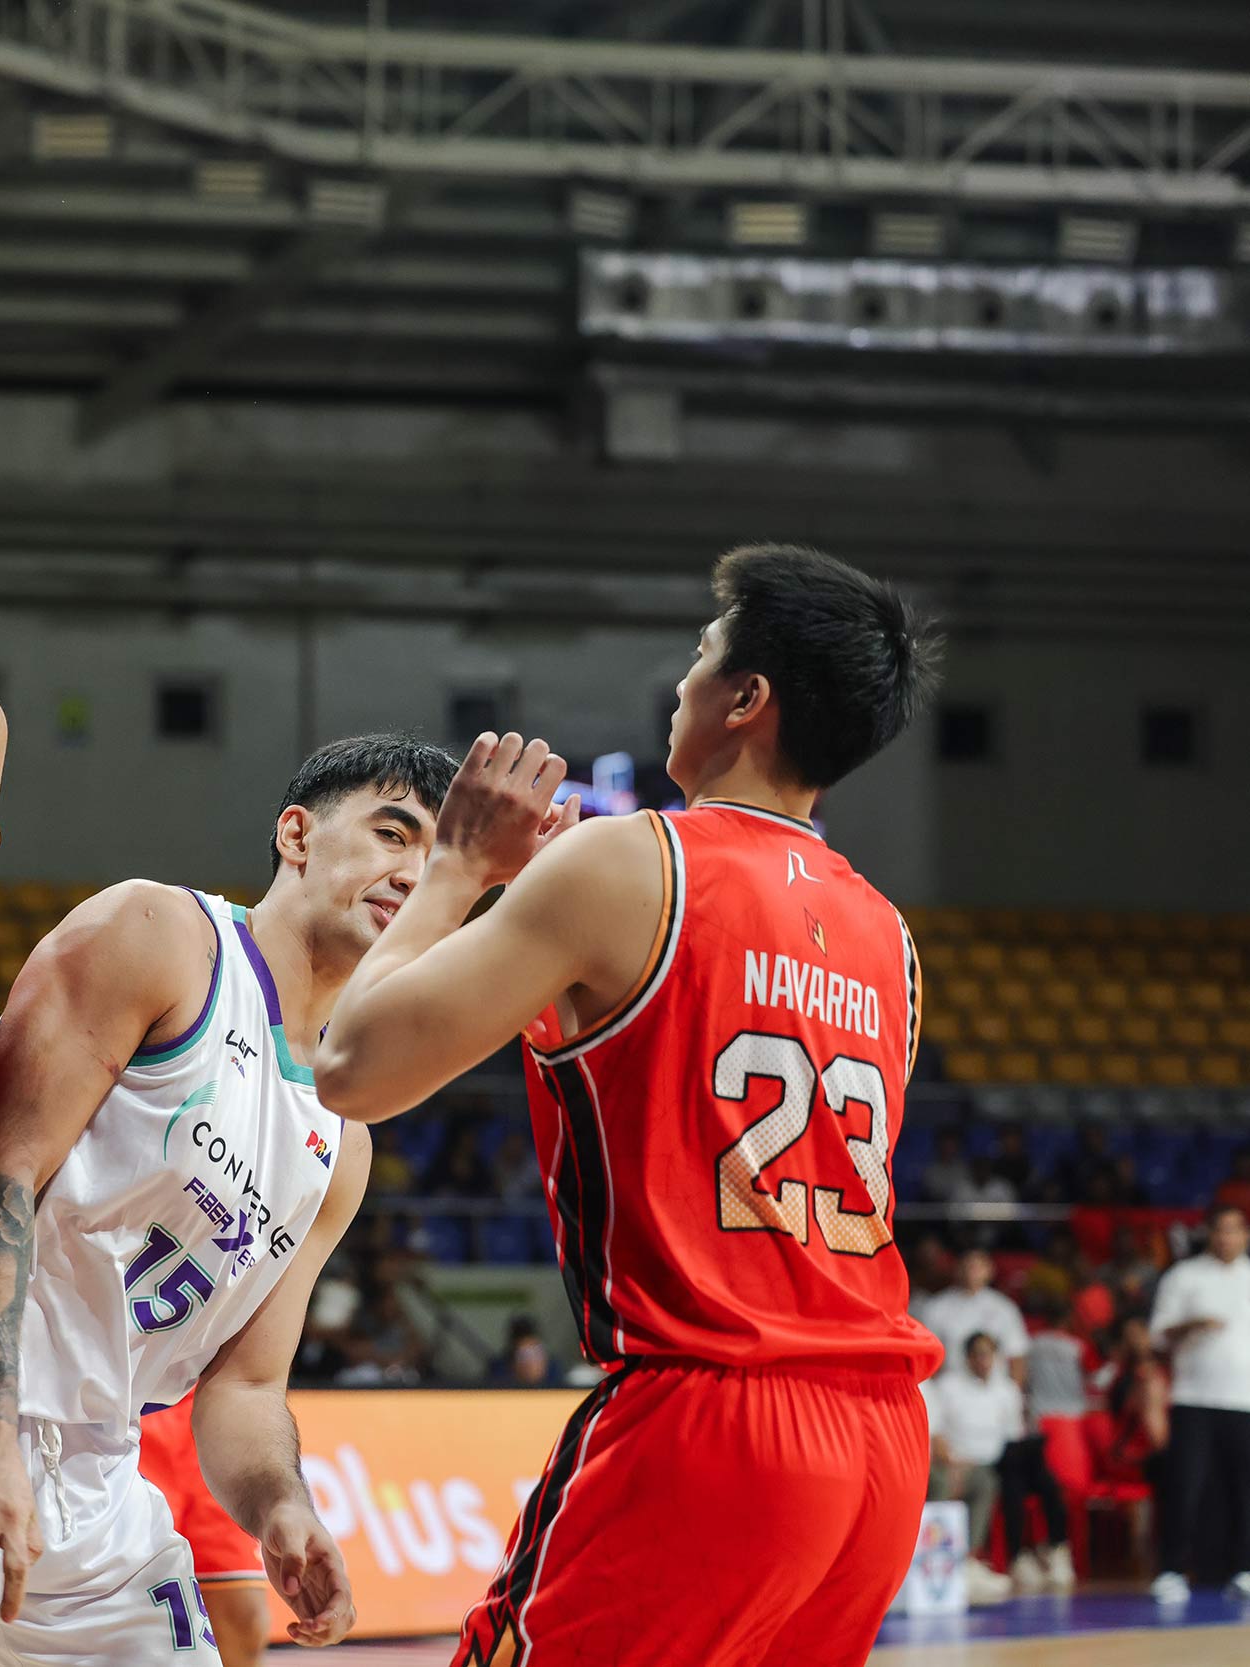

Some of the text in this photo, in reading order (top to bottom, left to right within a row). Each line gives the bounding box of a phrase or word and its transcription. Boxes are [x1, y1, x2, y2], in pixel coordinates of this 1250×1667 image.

[744, 949, 880, 1041] NAVARRO
[305, 1130, 333, 1170] PBA
[713, 1029, 893, 1259] 23
[124, 1221, 217, 1335] 15
